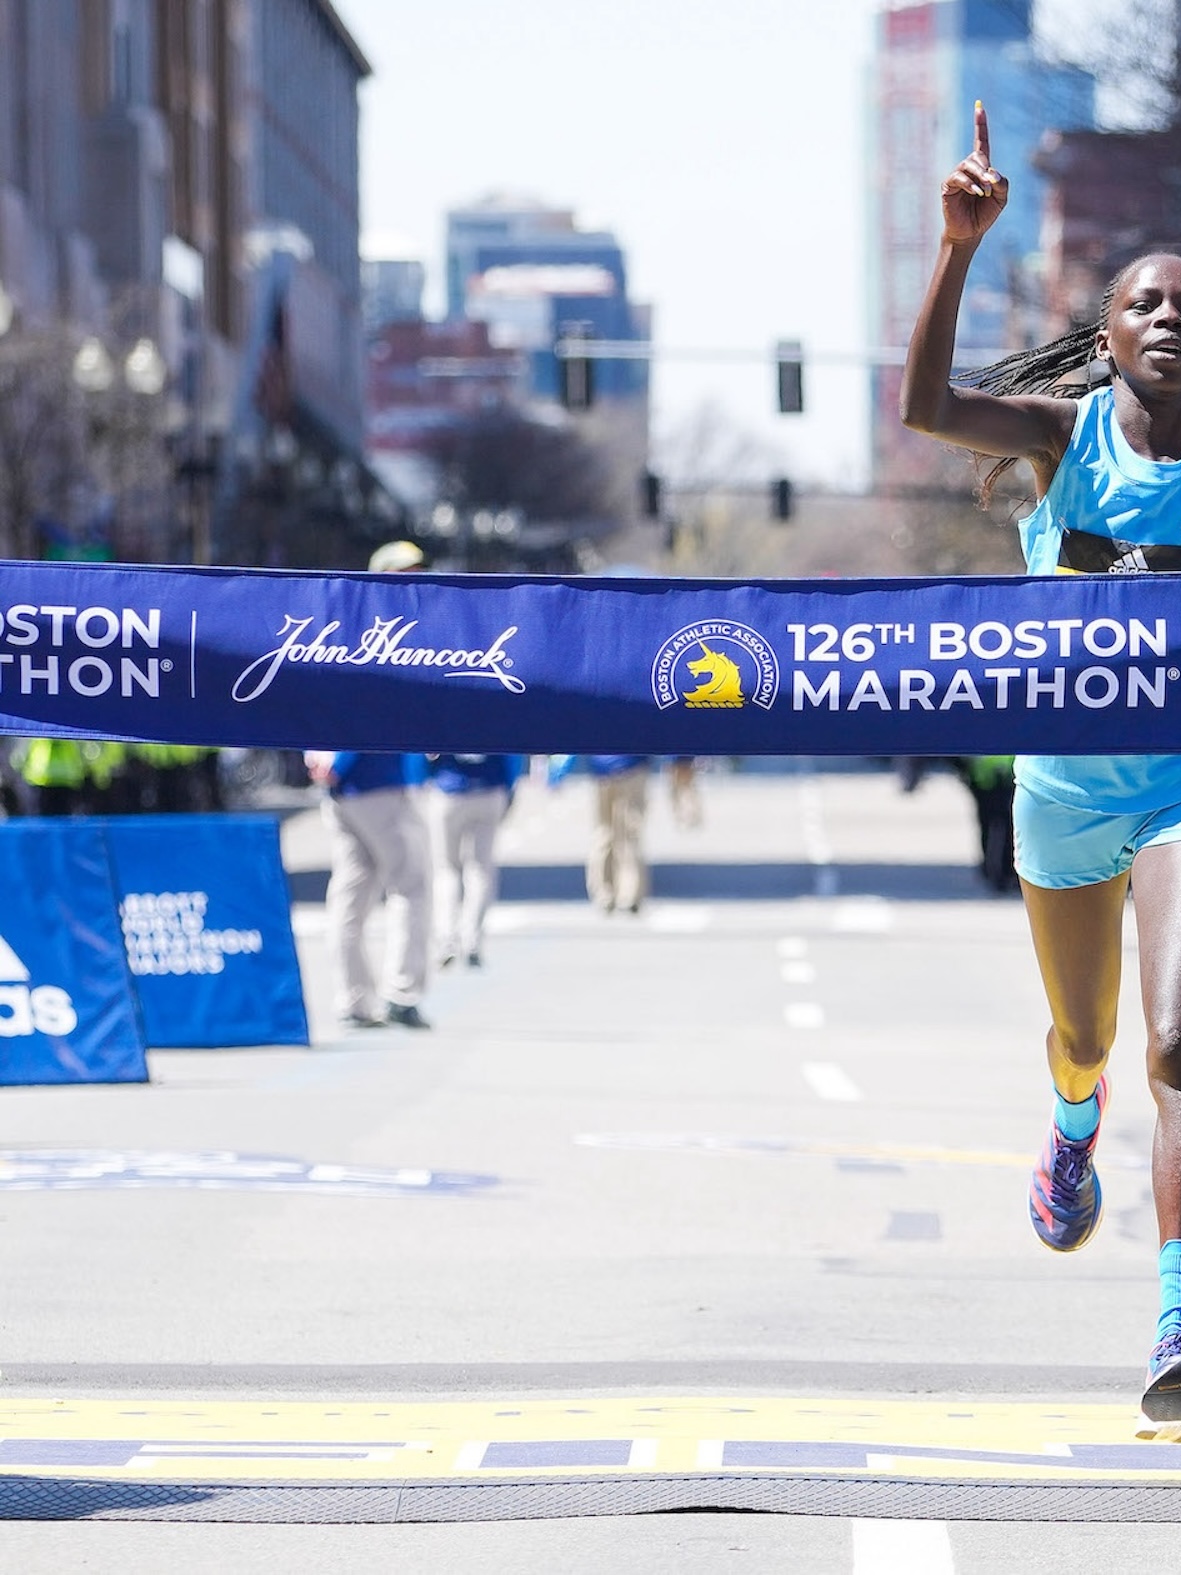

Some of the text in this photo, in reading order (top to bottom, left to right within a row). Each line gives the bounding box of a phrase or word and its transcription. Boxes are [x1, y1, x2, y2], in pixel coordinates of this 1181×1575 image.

[0, 604, 161, 648] STON
[787, 618, 1167, 662] 126TH BOSTON
[657, 624, 775, 703] BOSTON ATHLETIC ASSOCIATION
